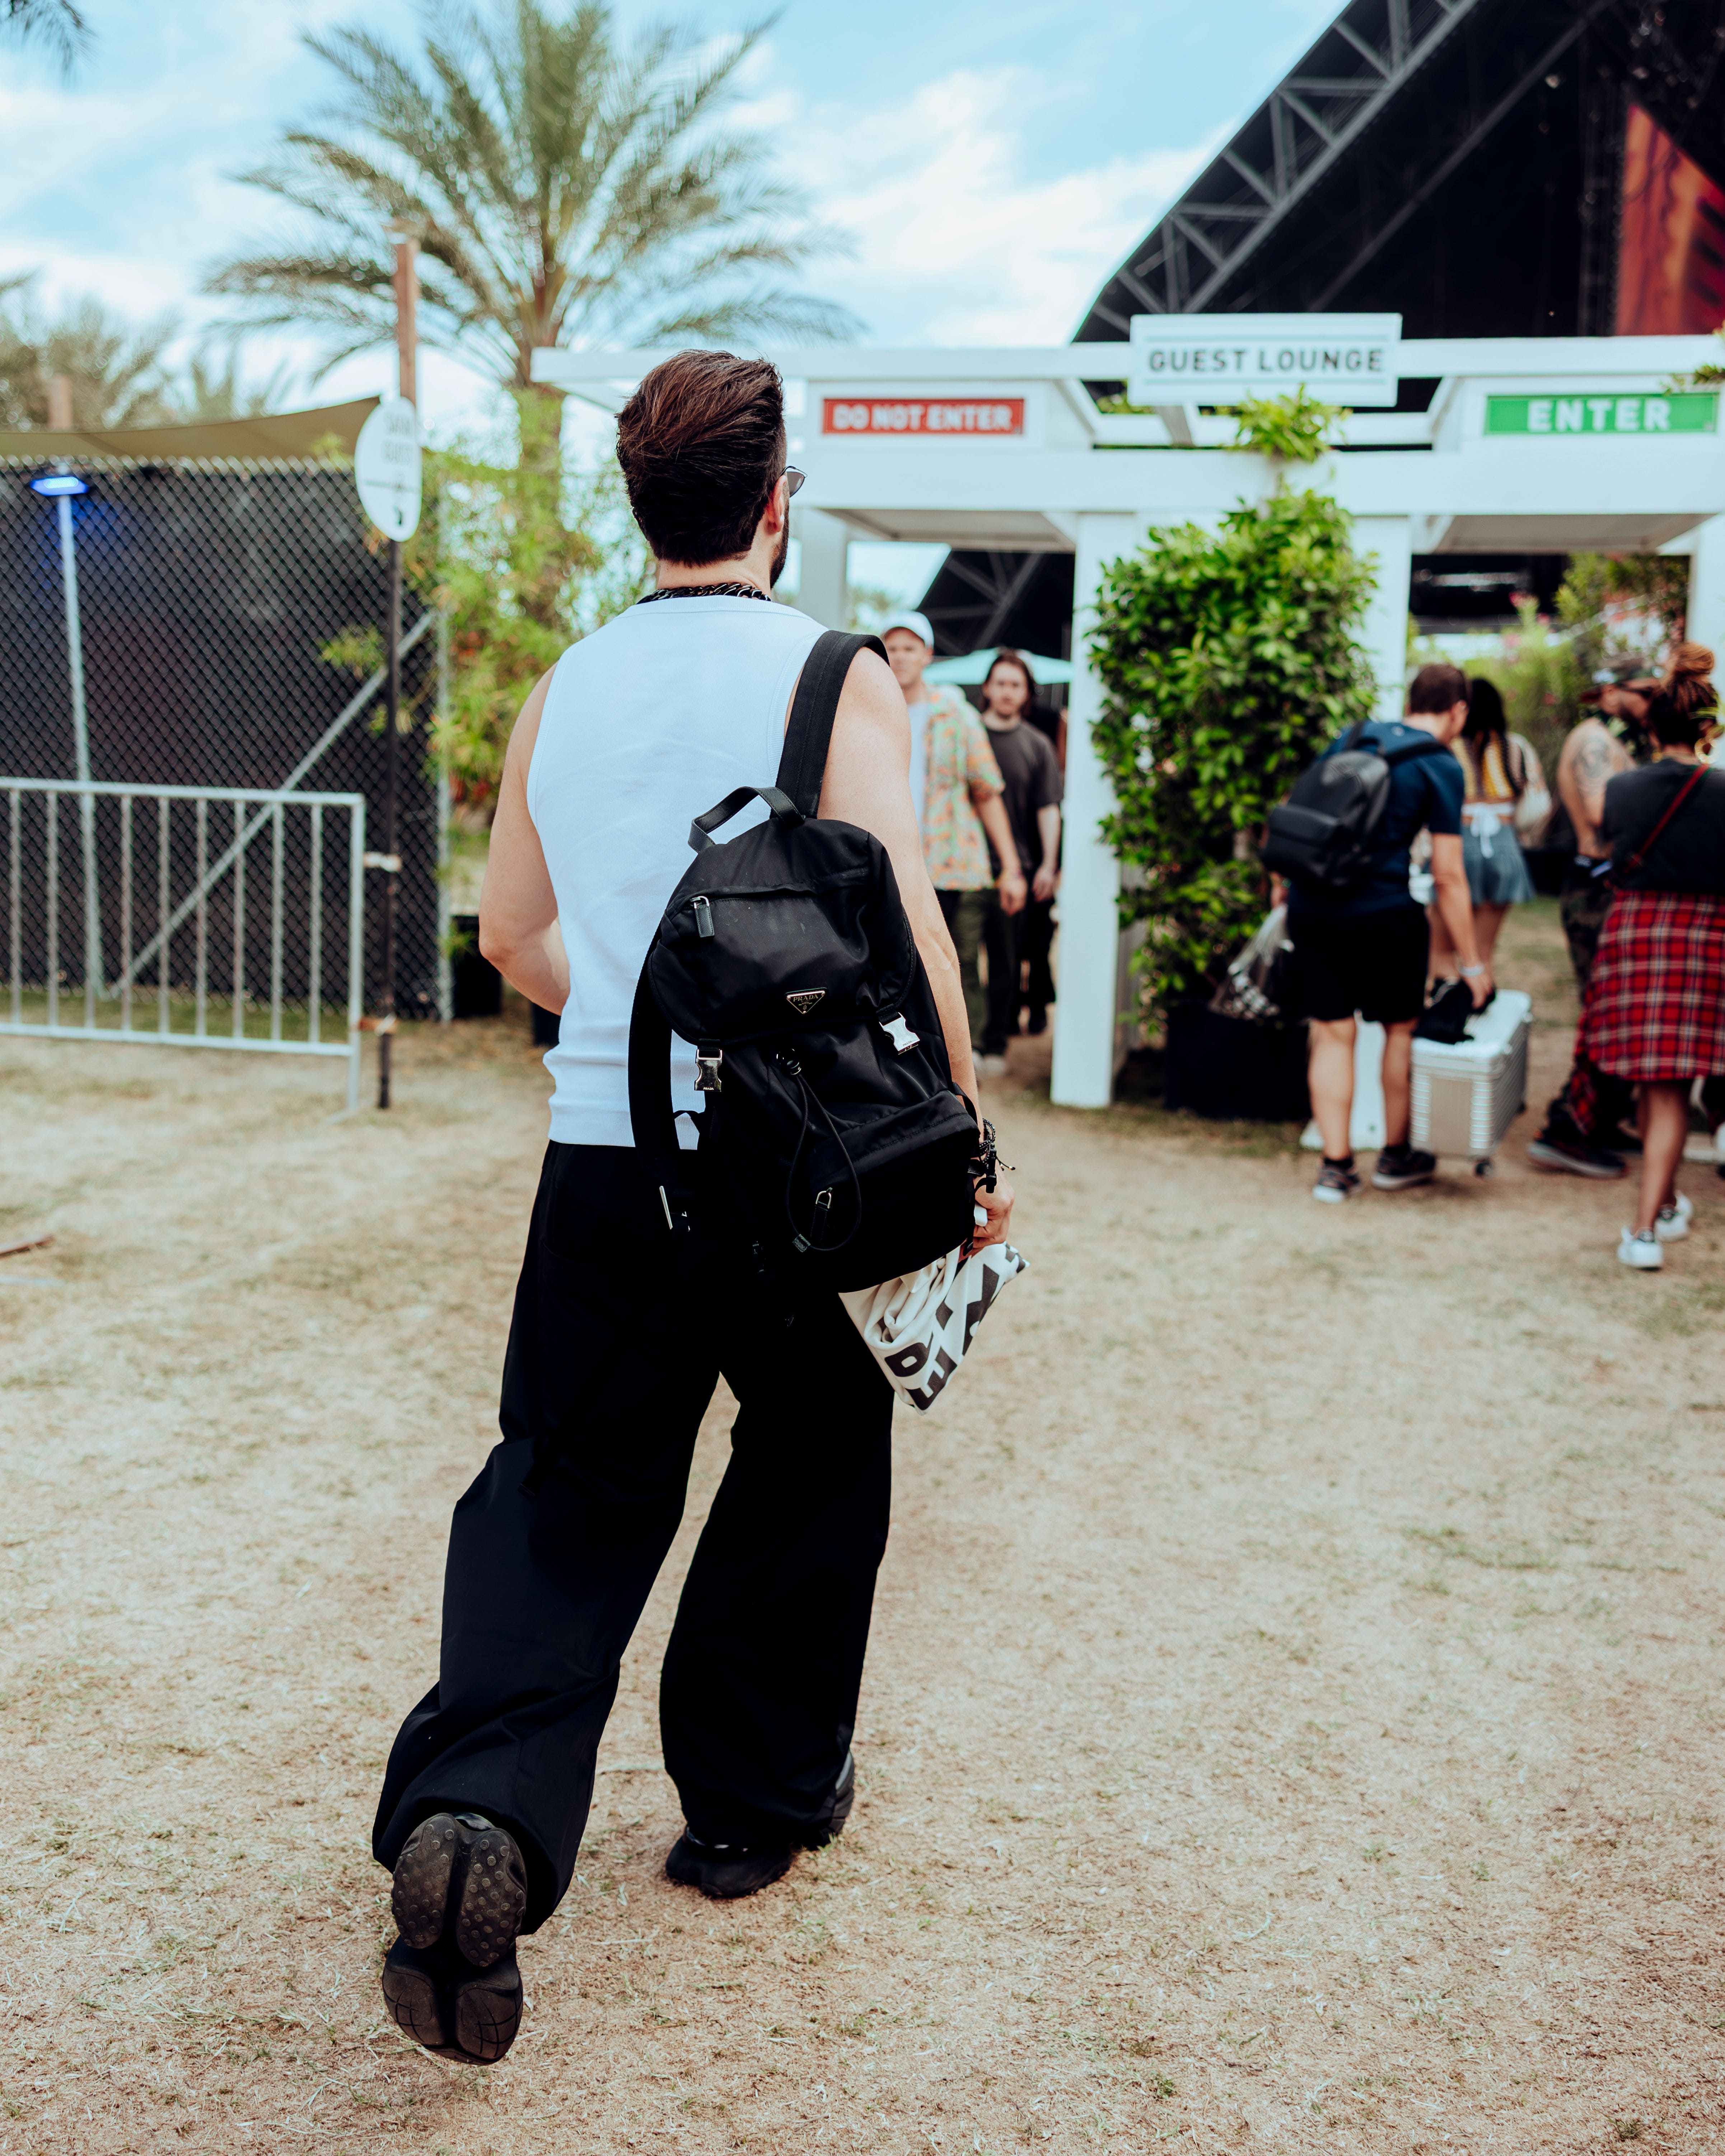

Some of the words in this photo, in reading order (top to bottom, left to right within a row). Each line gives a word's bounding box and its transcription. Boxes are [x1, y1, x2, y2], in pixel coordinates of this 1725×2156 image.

[1150, 349, 1246, 372] GUEST
[1258, 348, 1384, 371] LOUNGE
[832, 404, 870, 430] DO
[871, 404, 925, 430] NOT
[926, 405, 1013, 430] ENTER
[1527, 399, 1670, 431] ENTER
